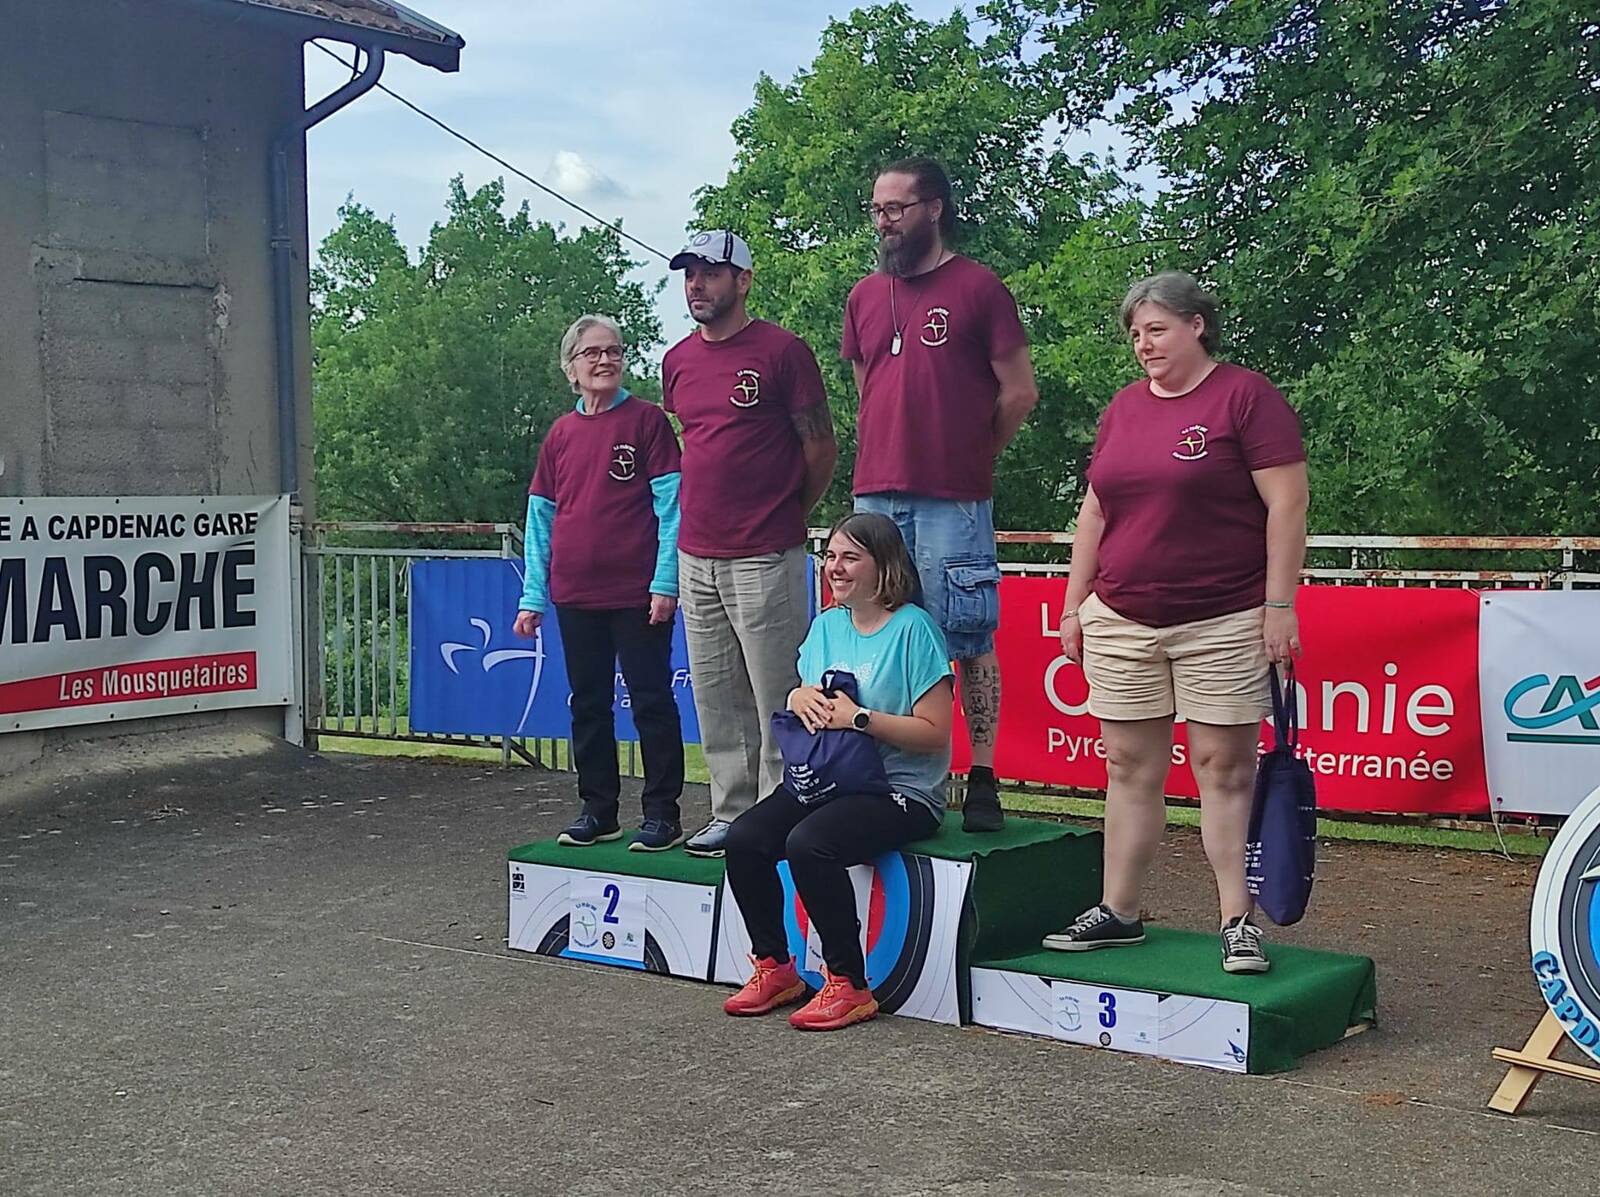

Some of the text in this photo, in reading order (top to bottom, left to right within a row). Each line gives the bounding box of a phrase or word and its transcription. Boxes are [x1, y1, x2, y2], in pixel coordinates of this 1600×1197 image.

[20, 516, 39, 541] A
[48, 513, 186, 541] CAPDENAC
[193, 511, 259, 538] GARE
[59, 662, 249, 702] Les Mousquetaires
[1047, 727, 1455, 782] Pyrés iterranée
[602, 884, 621, 925] 2
[1098, 991, 1117, 1029] 3
[1533, 950, 1600, 1057] CAPD
